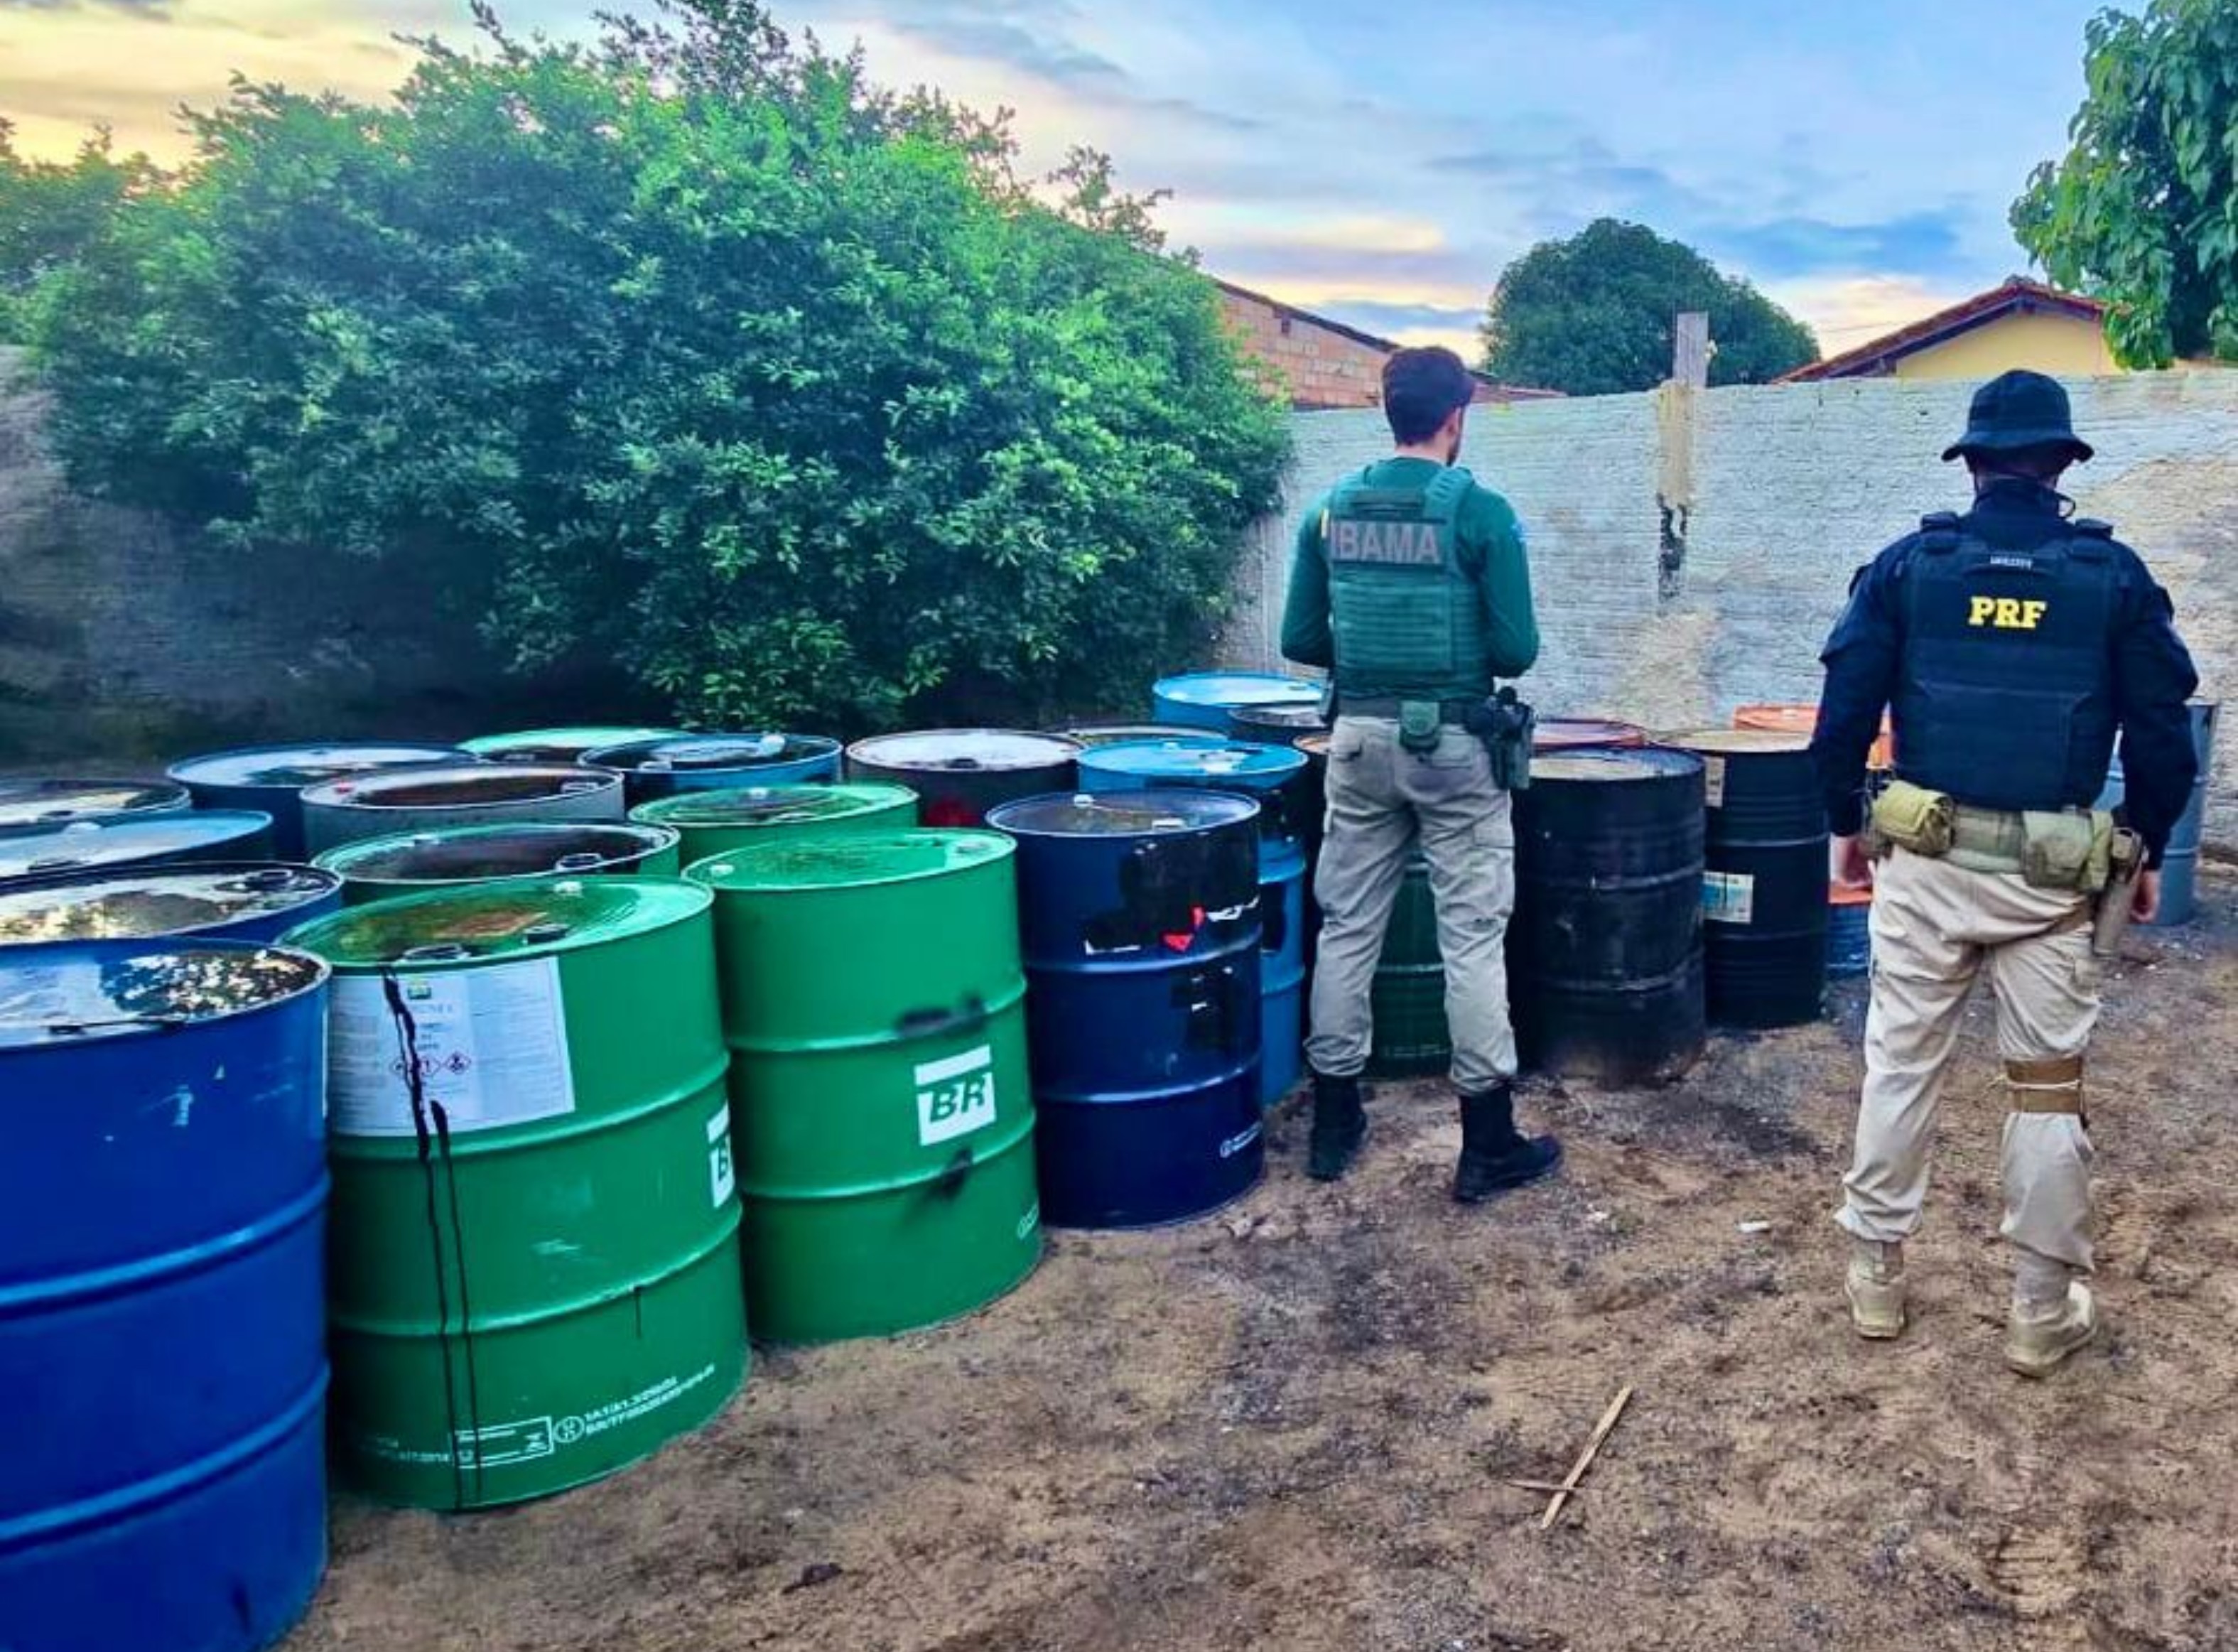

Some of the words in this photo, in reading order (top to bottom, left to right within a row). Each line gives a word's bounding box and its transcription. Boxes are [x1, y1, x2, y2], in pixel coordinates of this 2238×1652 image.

[1329, 519, 1442, 564] IBAMA
[1967, 595, 2048, 630] PRF
[929, 1074, 988, 1124] BR
